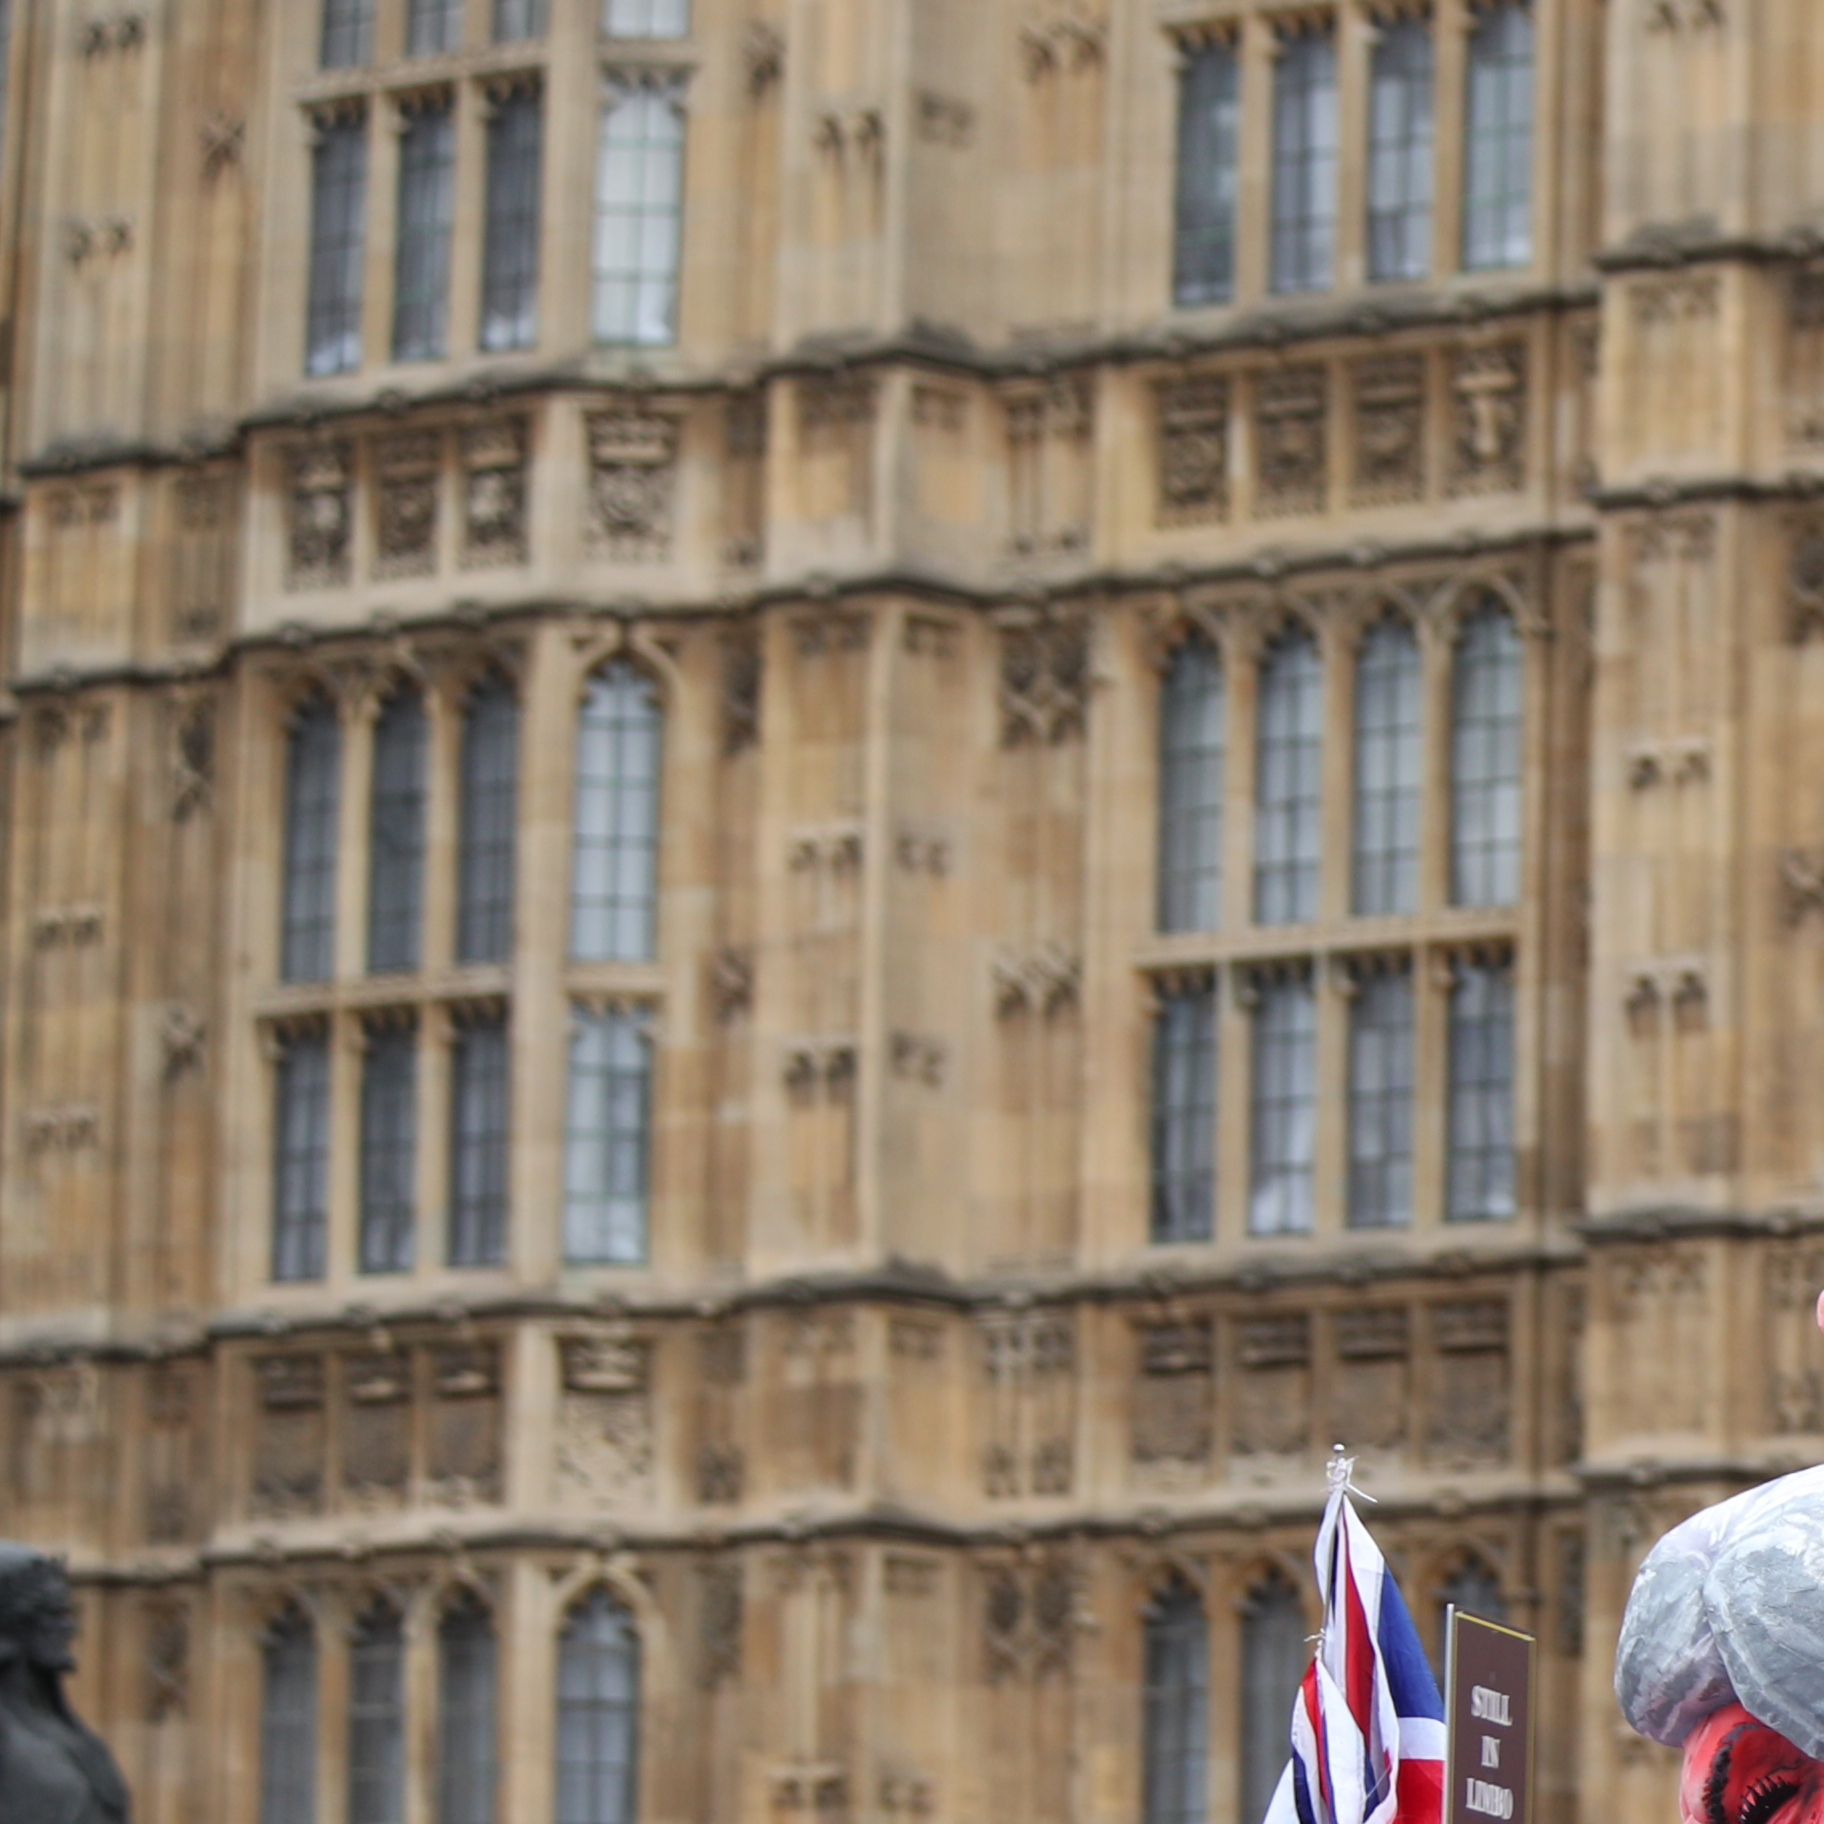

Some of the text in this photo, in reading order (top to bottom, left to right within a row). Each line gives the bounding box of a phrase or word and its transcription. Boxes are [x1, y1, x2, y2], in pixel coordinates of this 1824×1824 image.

[1471, 1685, 1513, 1726] STILL
[1481, 1735, 1501, 1768] IN
[1466, 1778, 1513, 1820] LIMBO
